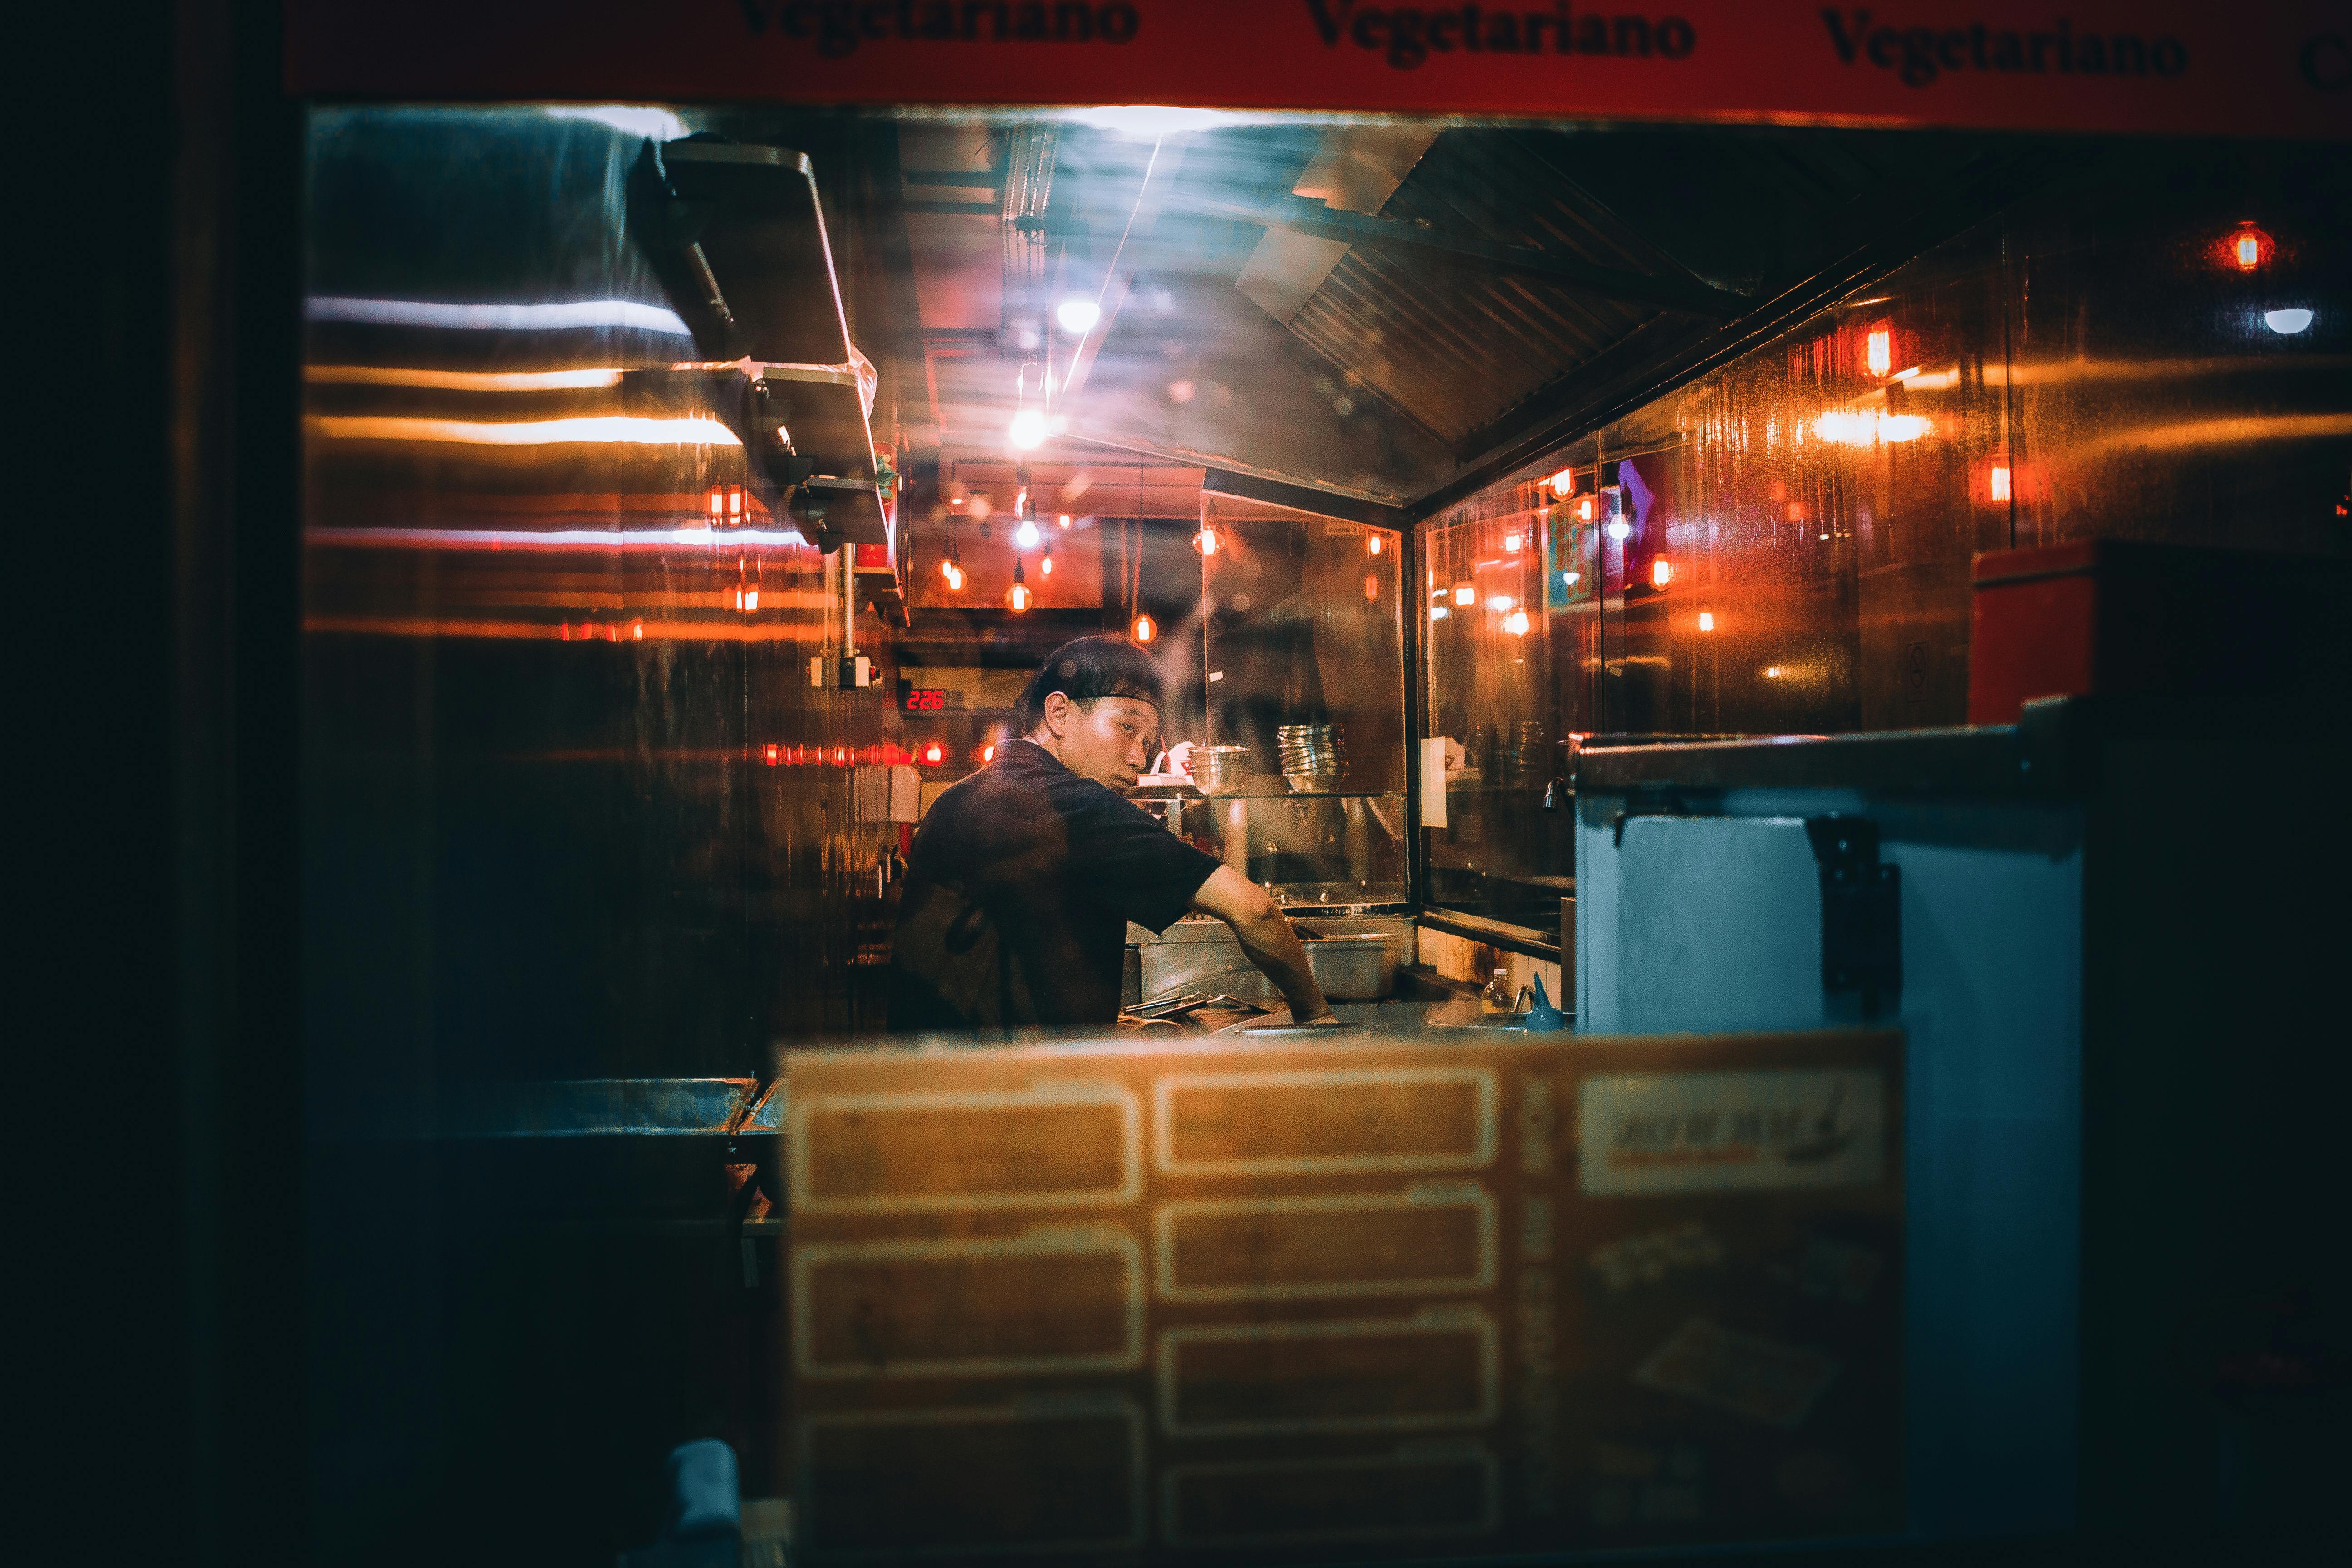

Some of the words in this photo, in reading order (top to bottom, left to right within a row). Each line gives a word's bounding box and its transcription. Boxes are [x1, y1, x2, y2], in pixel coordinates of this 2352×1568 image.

[737, 0, 1140, 59] Vegetariano
[1305, 0, 1696, 71] Vegetariano
[1820, 7, 2189, 88] Vegetariano
[907, 691, 944, 709] 226
